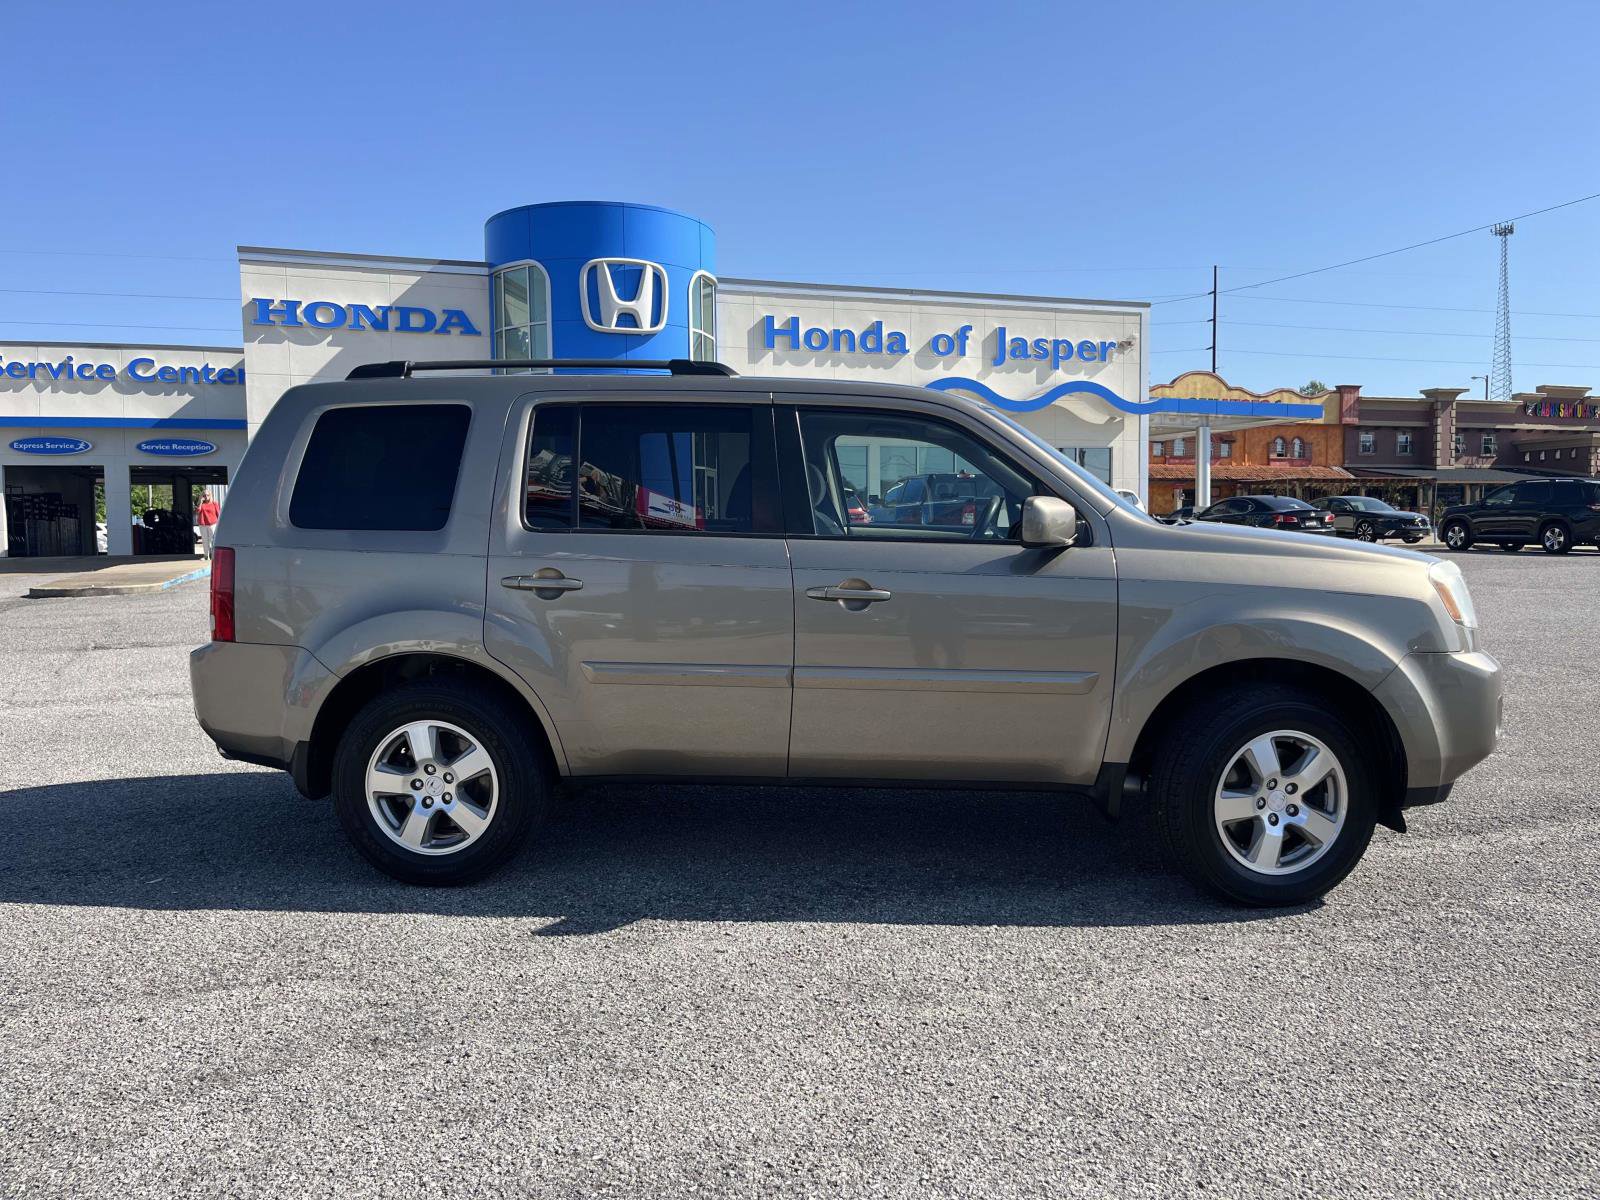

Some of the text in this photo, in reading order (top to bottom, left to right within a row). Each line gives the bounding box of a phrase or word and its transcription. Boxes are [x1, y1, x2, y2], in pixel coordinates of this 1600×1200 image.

[252, 297, 481, 336] HONDA
[763, 314, 1116, 370] Honda of Jasper
[0, 355, 117, 382] ervice
[13, 442, 44, 451] Express
[171, 443, 211, 451] Reception
